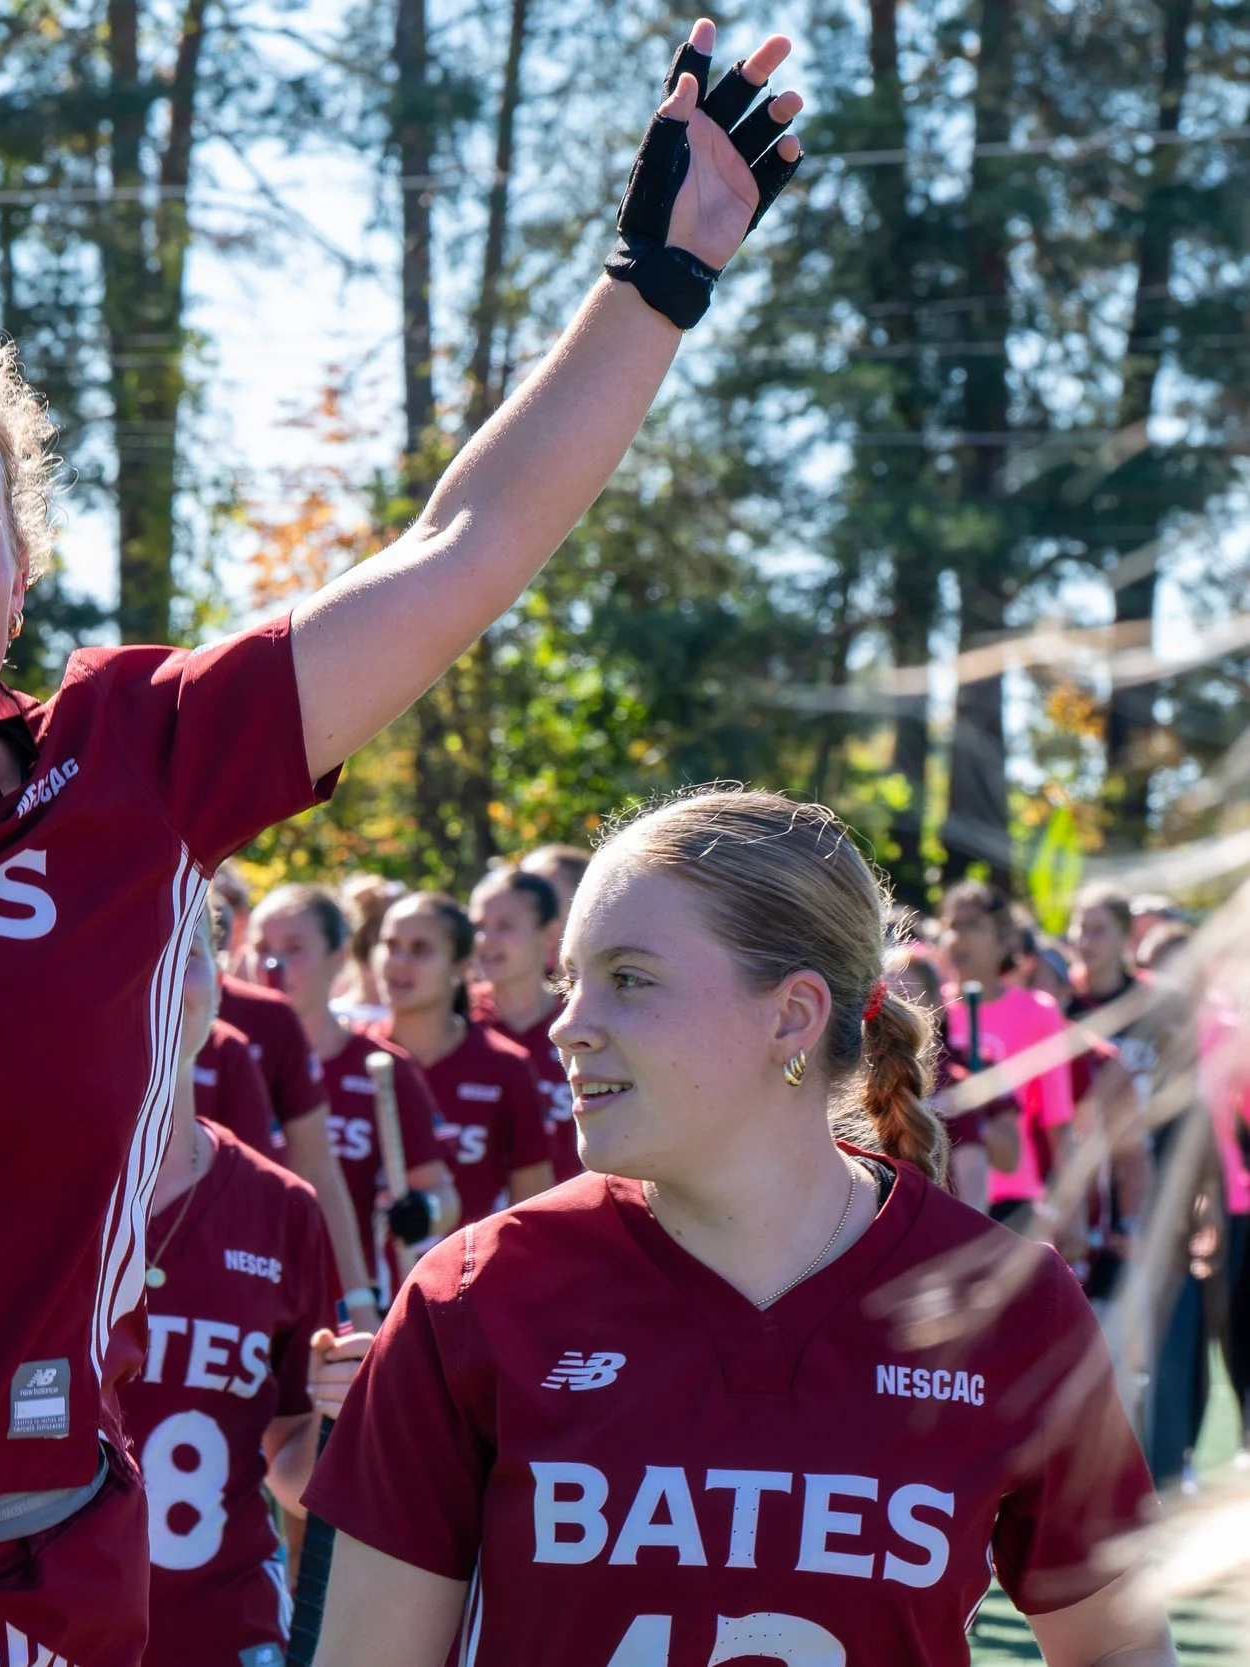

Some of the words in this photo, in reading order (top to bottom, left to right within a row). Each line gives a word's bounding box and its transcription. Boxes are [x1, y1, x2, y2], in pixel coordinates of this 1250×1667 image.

[876, 1364, 986, 1407] NESCAC
[141, 1409, 230, 1571] 8
[529, 1461, 955, 1589] BATES
